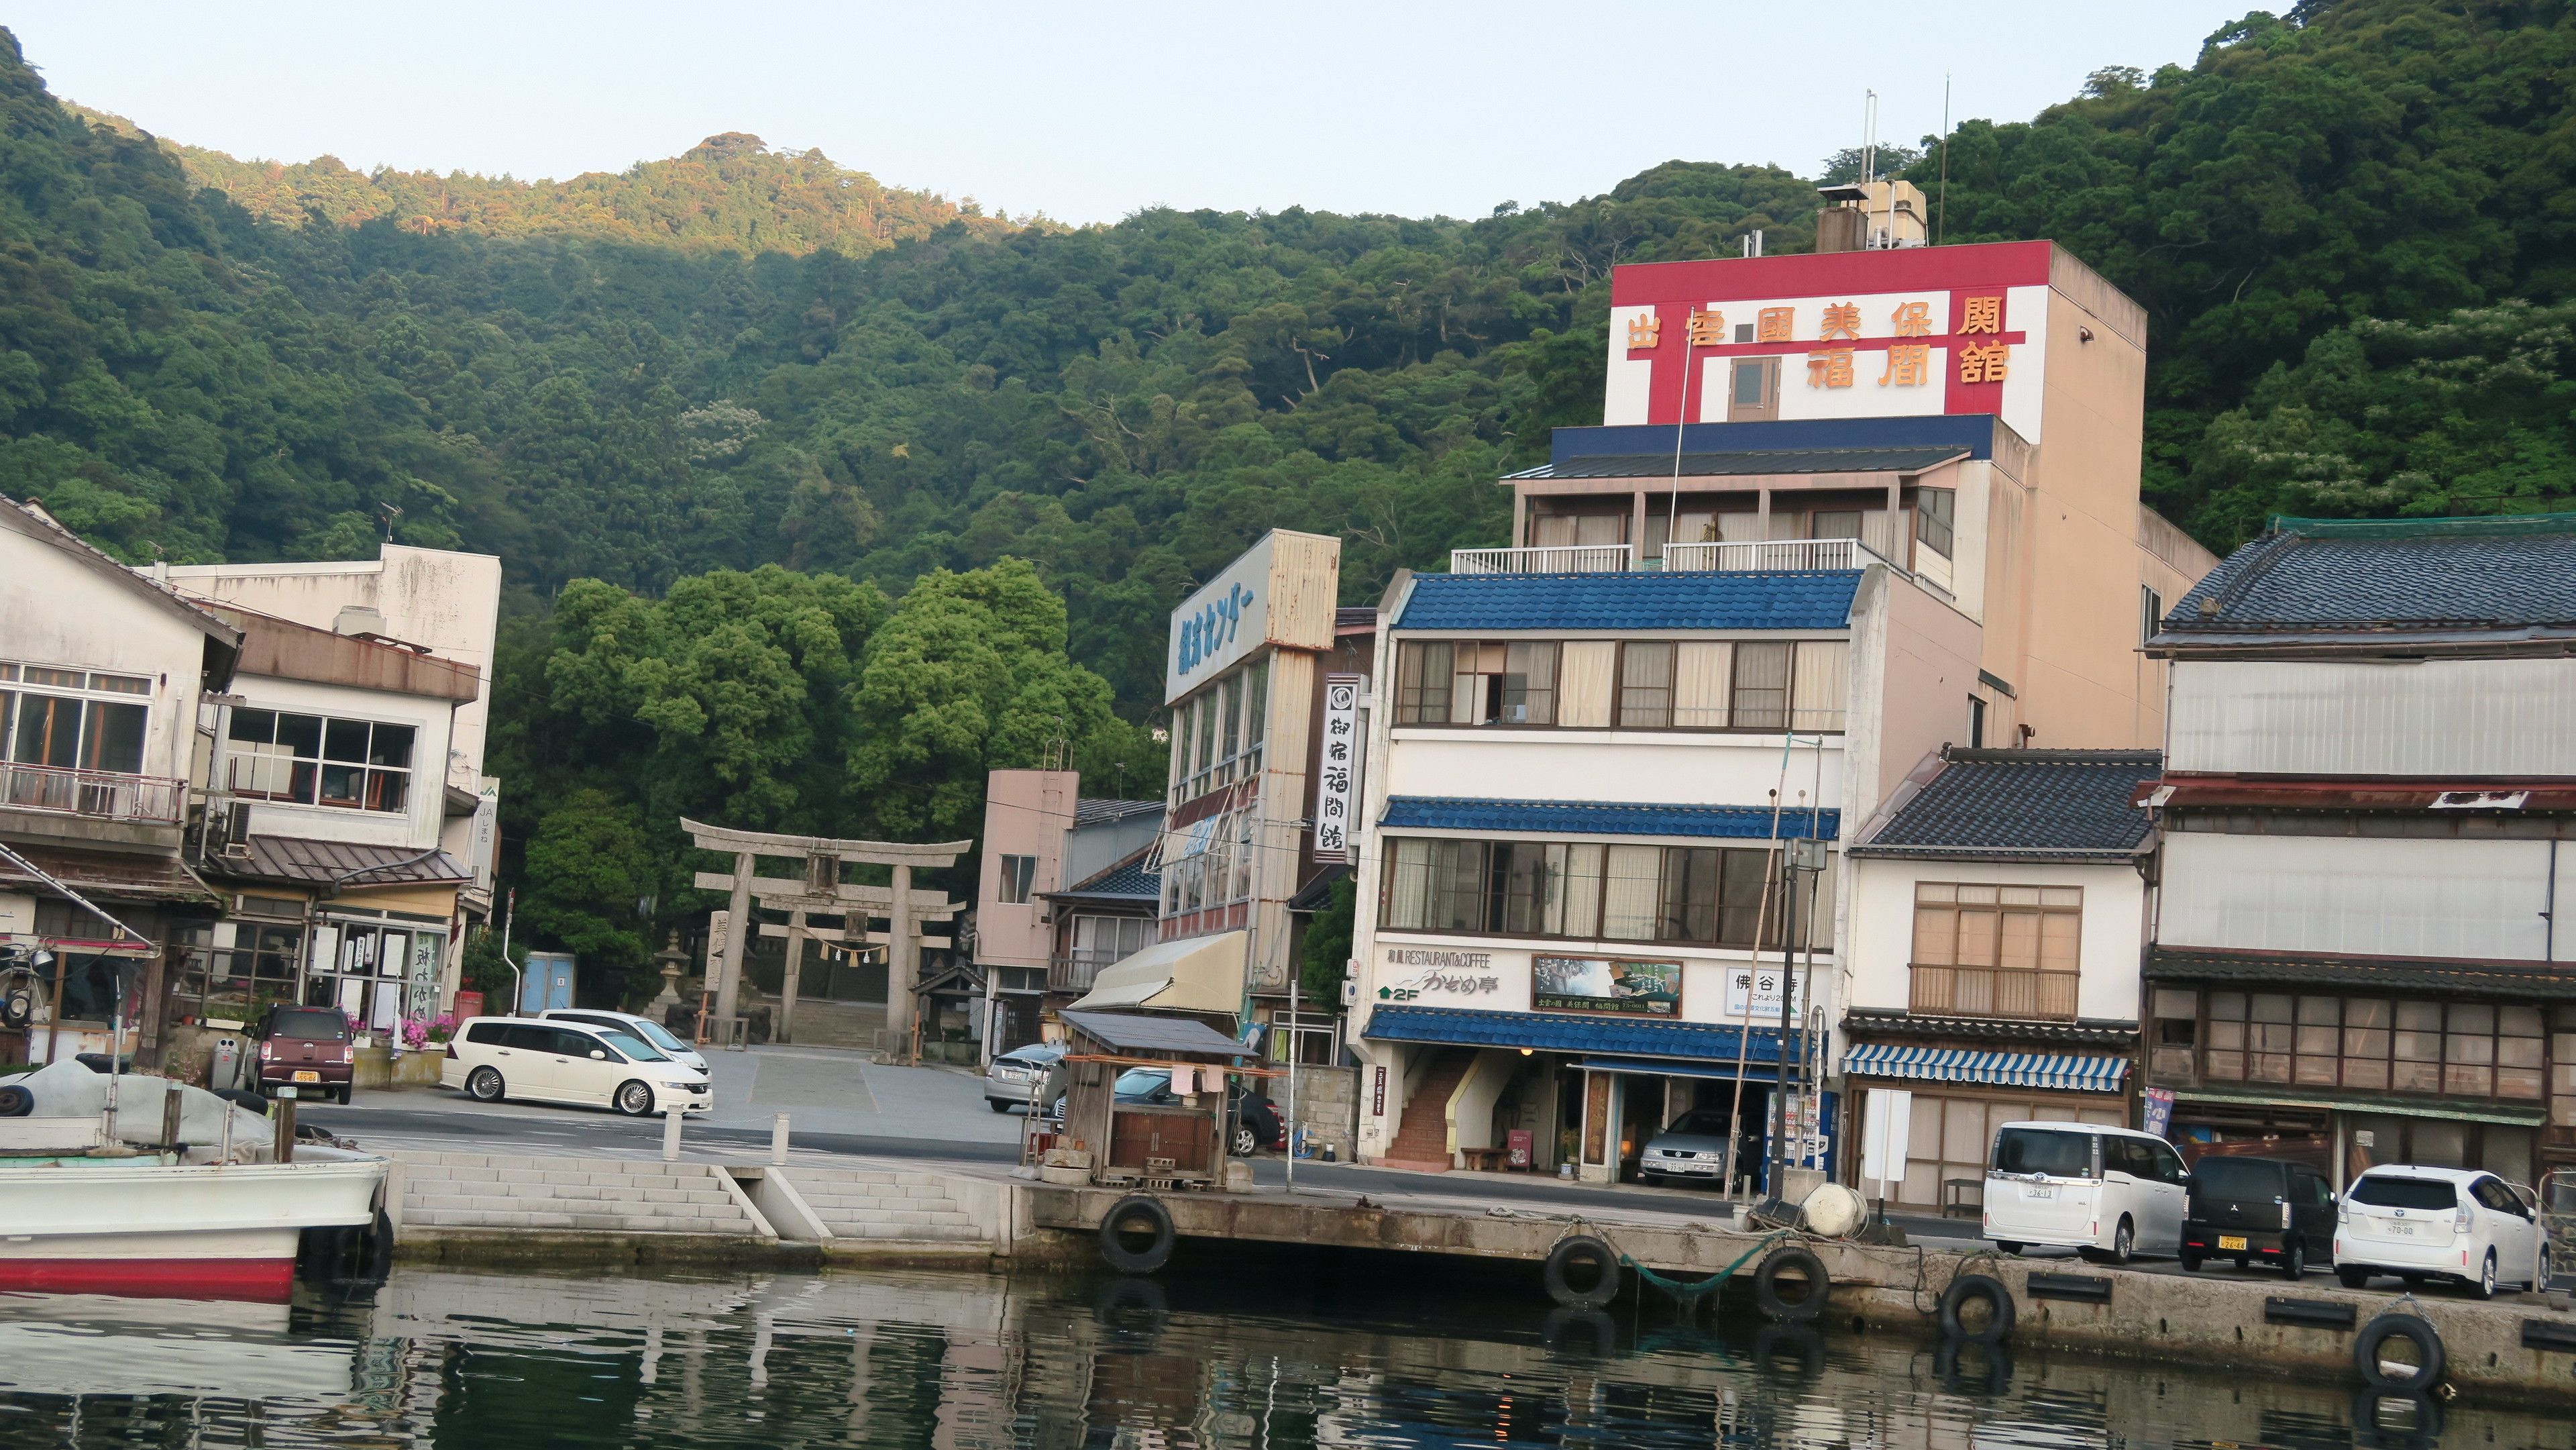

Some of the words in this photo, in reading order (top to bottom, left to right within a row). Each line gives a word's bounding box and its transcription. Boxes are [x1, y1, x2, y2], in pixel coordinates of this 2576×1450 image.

[1320, 716, 1350, 849] 御宿福間館
[1405, 950, 1492, 968] RESTAURANT&COFFEE
[1421, 971, 1499, 996] かもめ亭
[1393, 988, 1420, 1001] 2F
[2033, 1189, 2051, 1198] 36-13
